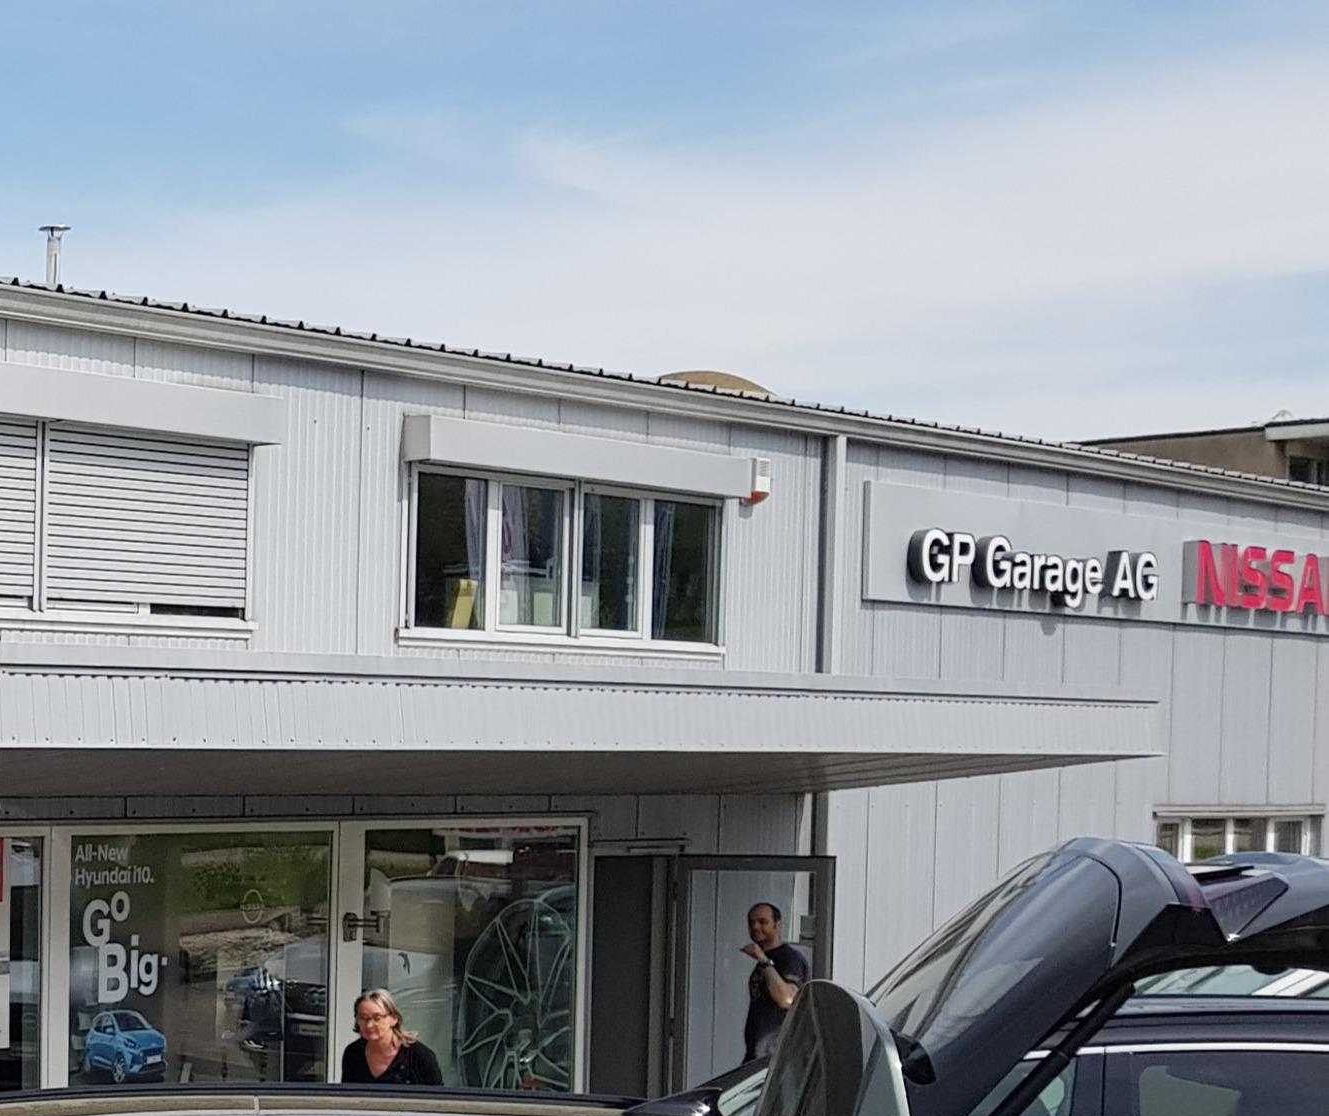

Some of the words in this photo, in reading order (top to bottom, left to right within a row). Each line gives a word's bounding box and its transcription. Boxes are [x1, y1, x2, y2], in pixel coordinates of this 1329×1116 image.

[921, 527, 976, 583] GP
[985, 534, 1103, 609] Garage
[1111, 550, 1160, 601] AG
[1196, 539, 1329, 616] NISSA
[74, 844, 129, 862] All-New
[75, 867, 132, 888] Hyundai
[83, 891, 131, 947] Go
